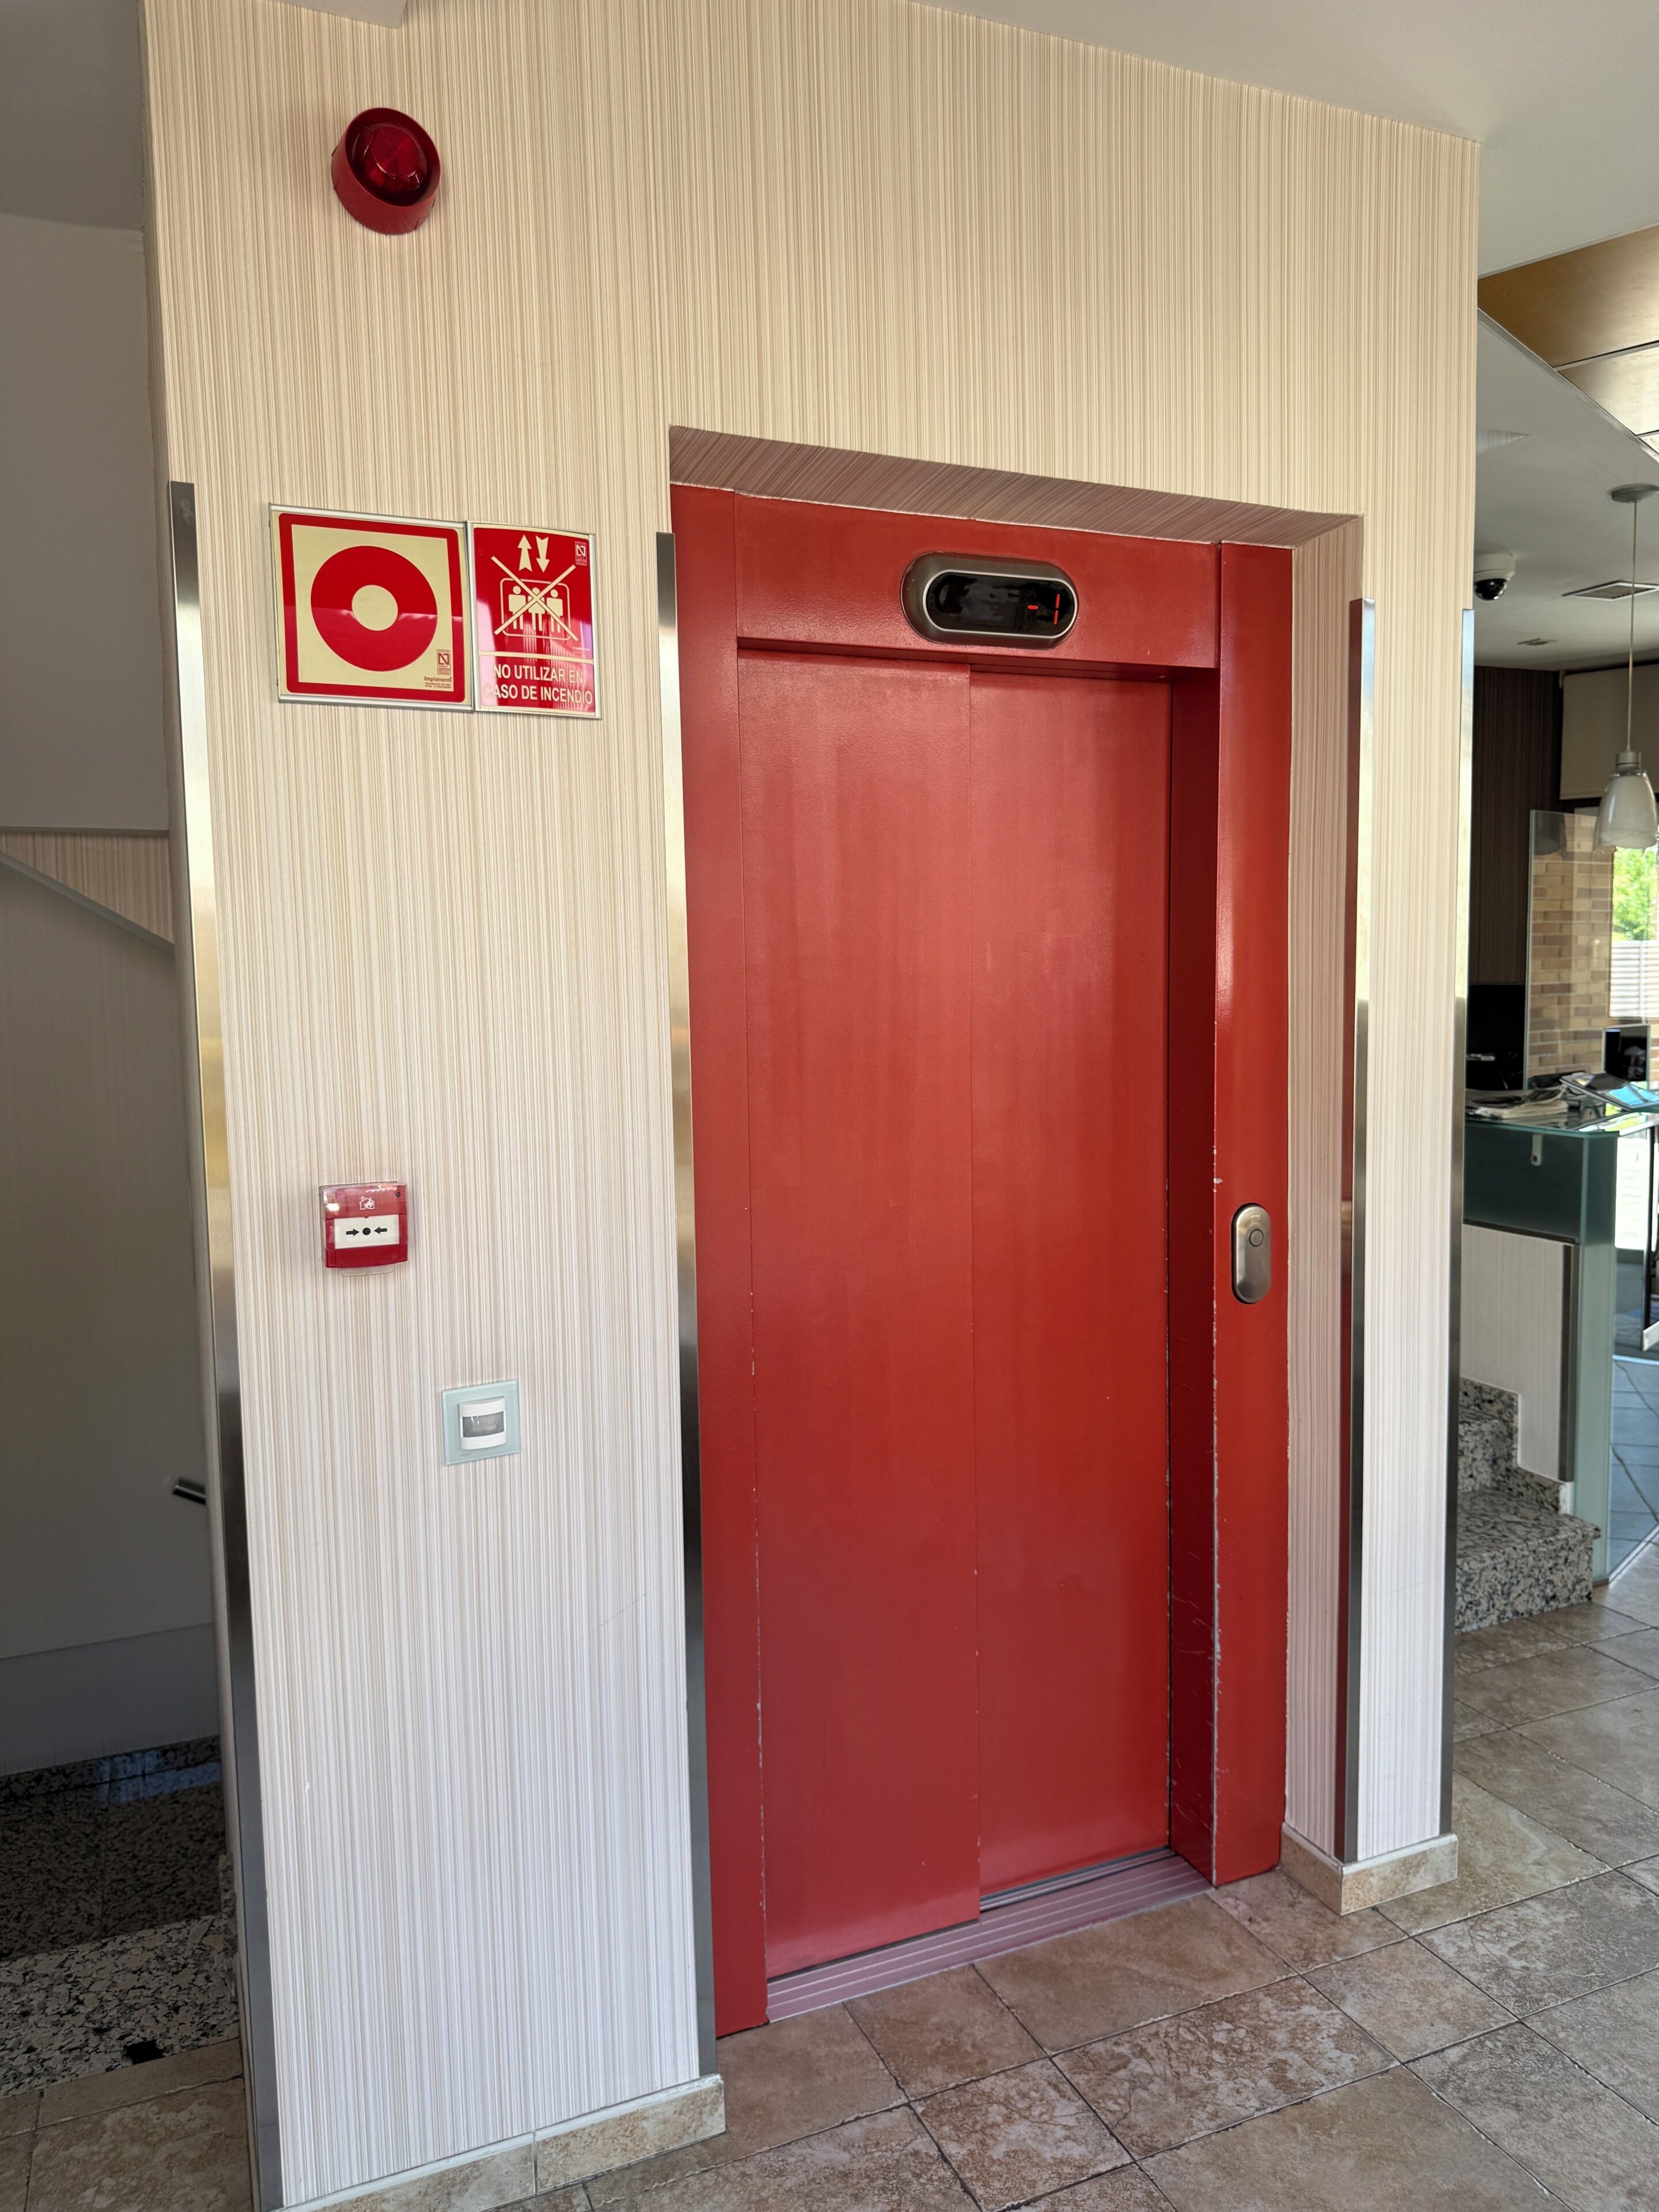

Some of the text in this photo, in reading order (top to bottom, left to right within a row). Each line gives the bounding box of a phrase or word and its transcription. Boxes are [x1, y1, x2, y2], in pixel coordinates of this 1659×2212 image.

[494, 664, 584, 684] NO UTILIZAR EN
[483, 683, 593, 705] CASO DE INCENDIO
